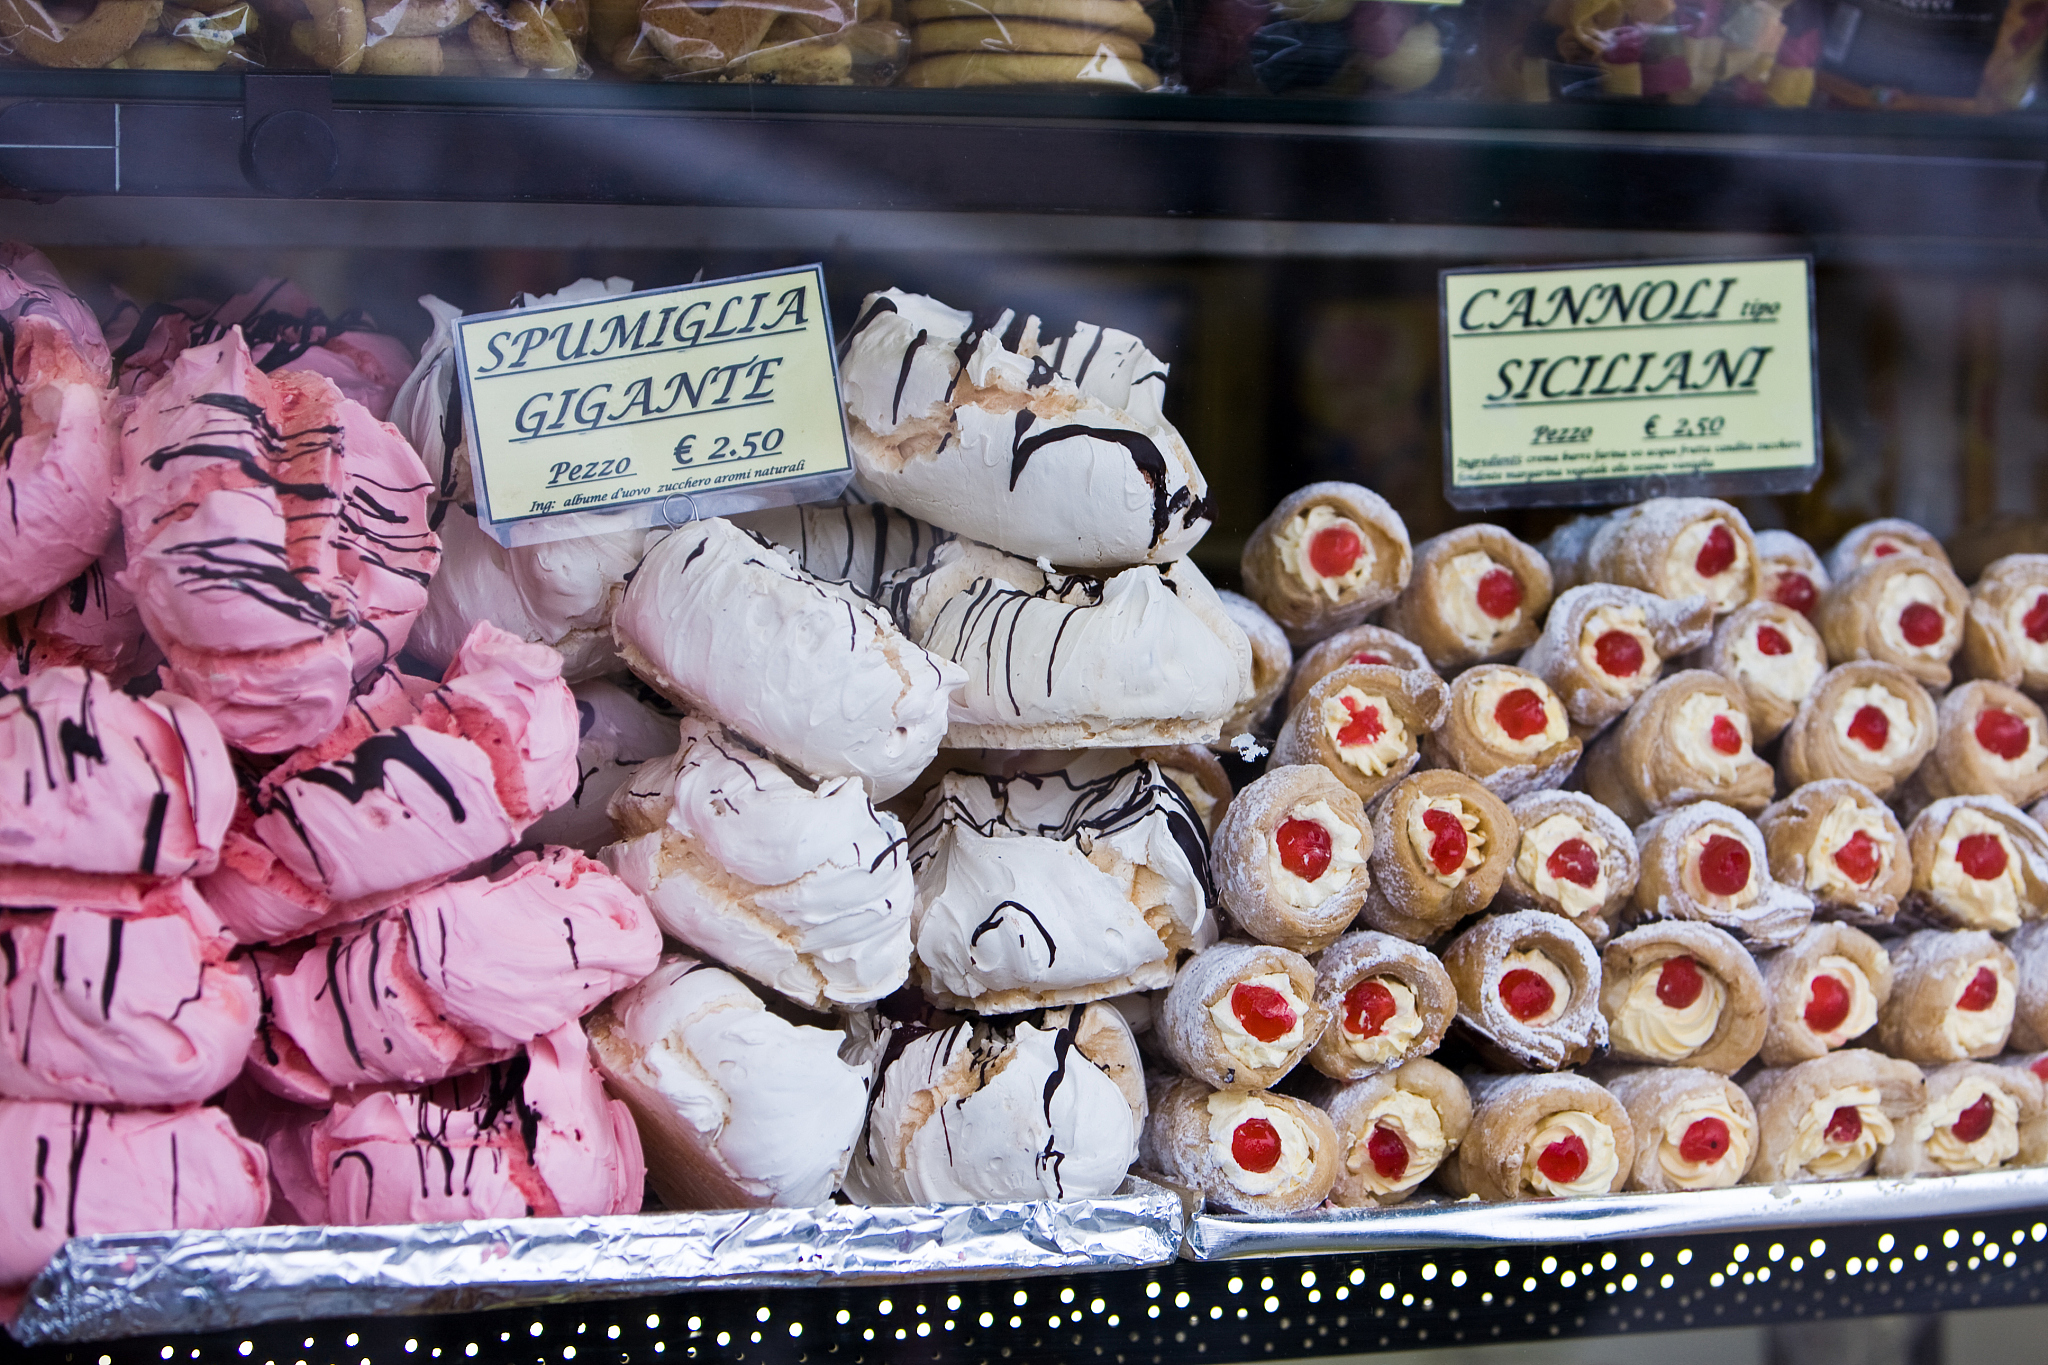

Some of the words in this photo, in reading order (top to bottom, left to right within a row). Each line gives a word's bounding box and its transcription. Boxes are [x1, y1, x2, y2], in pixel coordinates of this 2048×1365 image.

[476, 284, 809, 373] SPUMIGLIA
[1459, 277, 1738, 331] CANNOLI
[1740, 297, 1782, 322] tipo
[513, 354, 784, 438] GIGANTE
[1486, 346, 1774, 402] SICILIANI
[547, 456, 631, 485] Pezzo
[673, 433, 698, 465] €
[708, 427, 785, 461] 2.50
[1531, 423, 1594, 443] Pezzo
[1644, 414, 1661, 437] €
[1673, 415, 1725, 437] 2,50
[529, 500, 556, 514] Ing:
[563, 493, 608, 508] albume
[611, 486, 651, 500] d'uovo
[657, 476, 711, 493] zucchero
[713, 468, 752, 484] aromi
[753, 459, 805, 478] naturali
